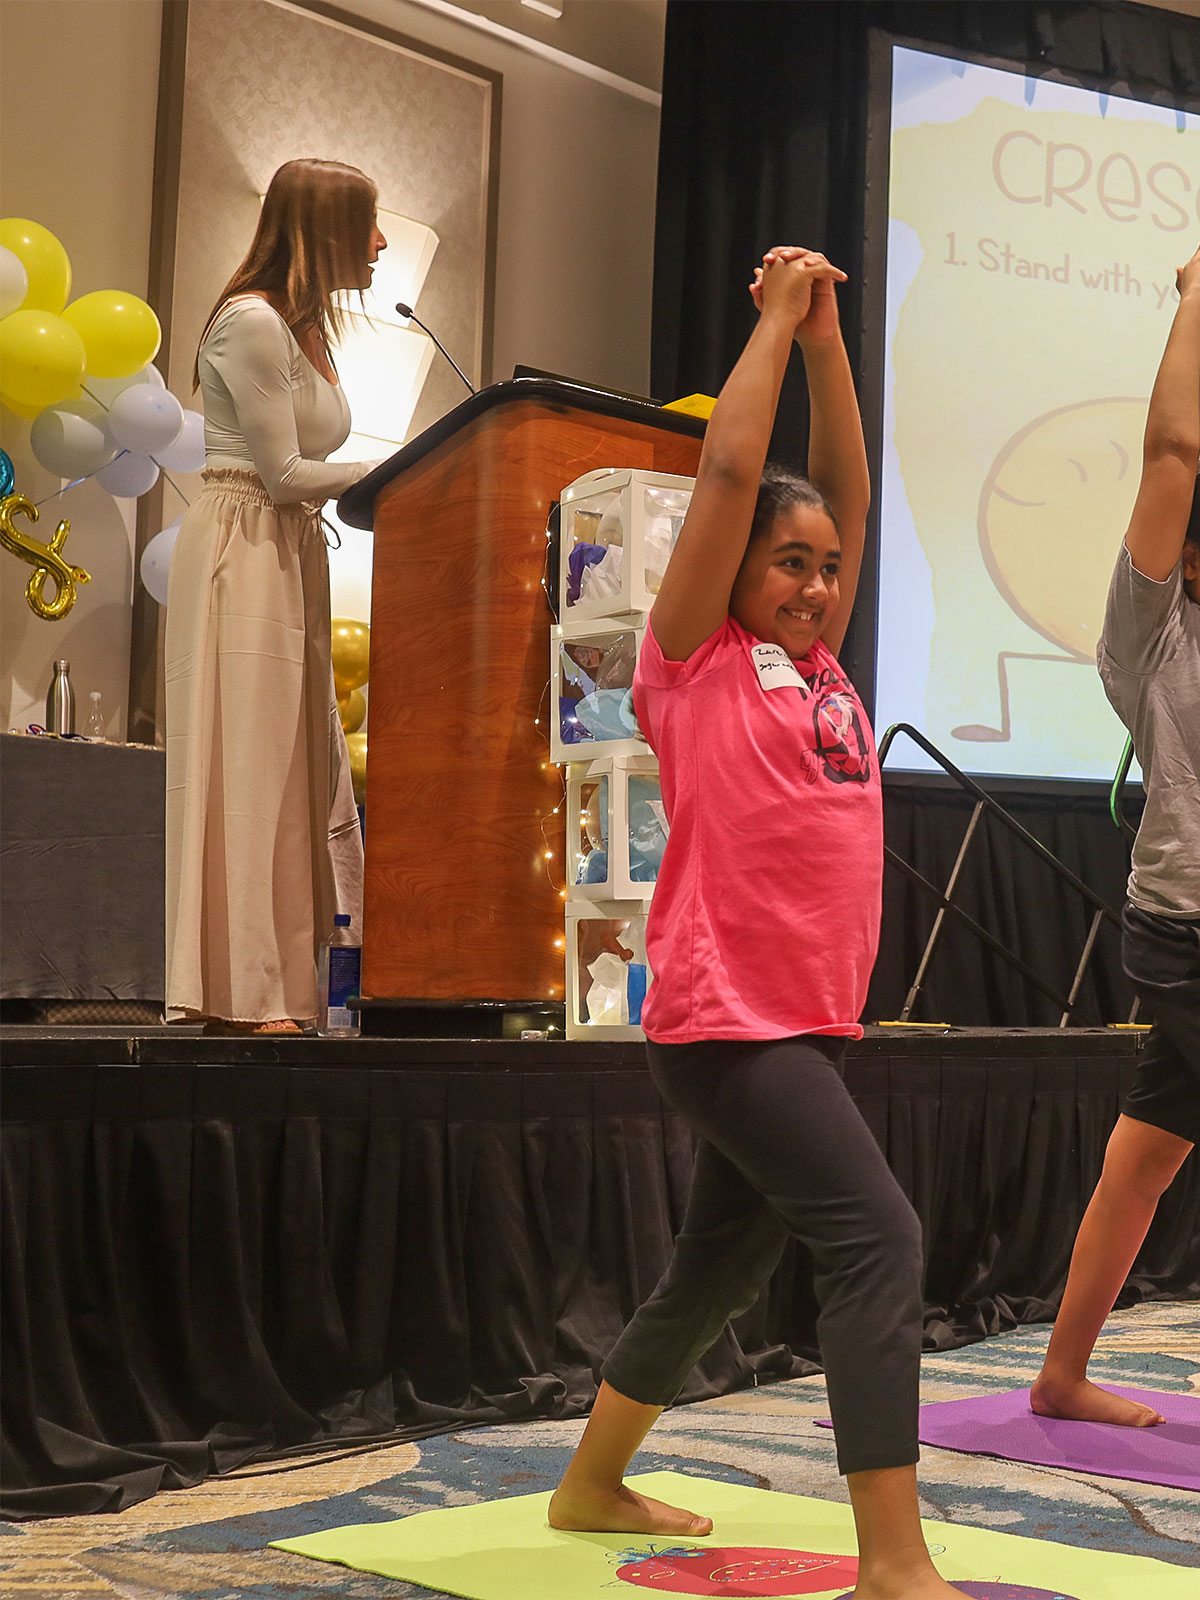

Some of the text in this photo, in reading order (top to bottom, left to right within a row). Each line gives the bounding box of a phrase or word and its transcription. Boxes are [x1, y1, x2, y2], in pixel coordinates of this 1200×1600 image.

[945, 232, 967, 266] 1.
[978, 238, 1070, 284] Stand
[1080, 263, 1141, 296] with
